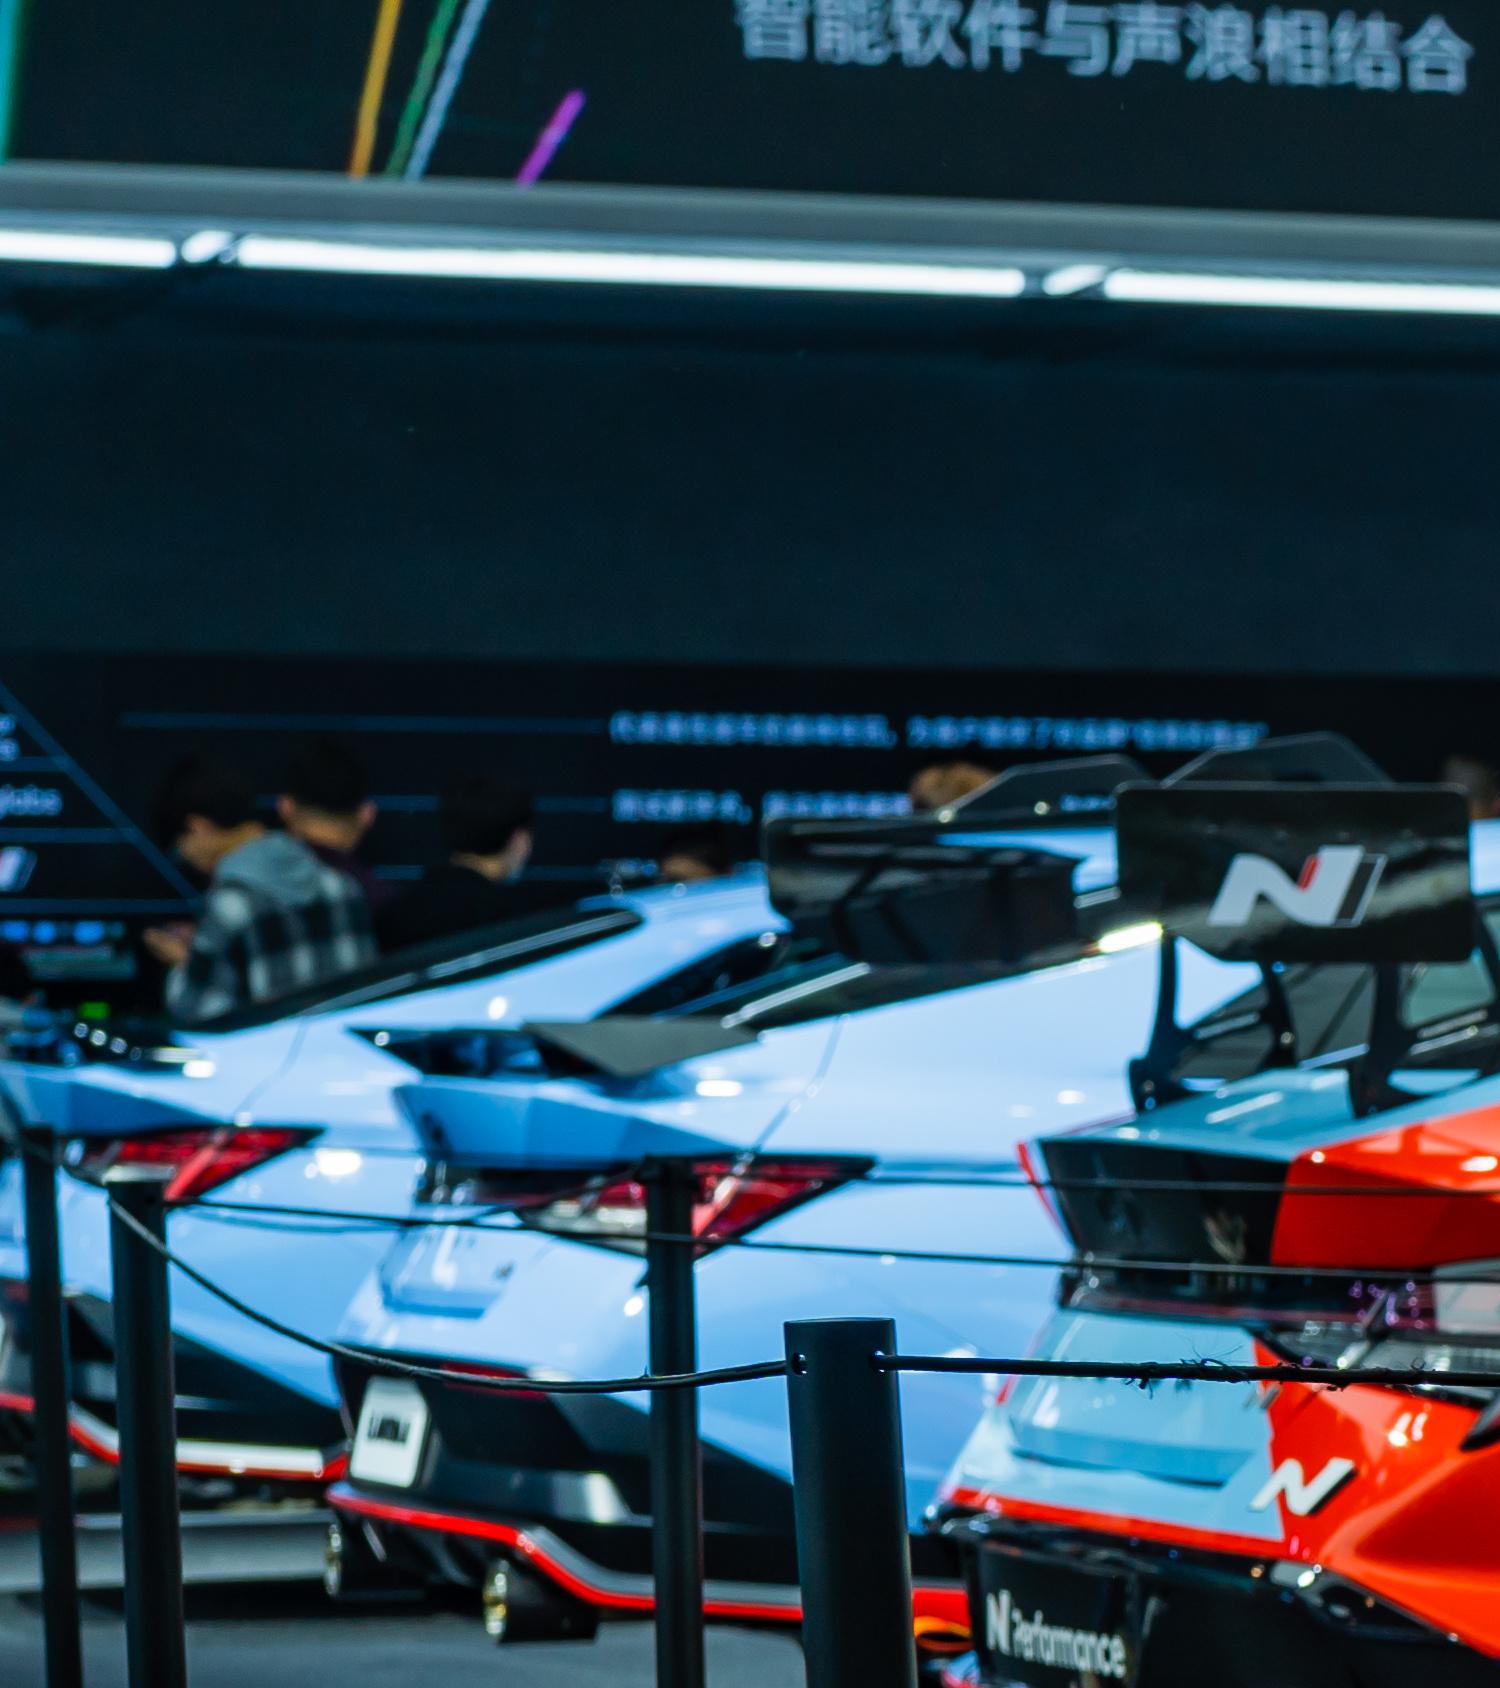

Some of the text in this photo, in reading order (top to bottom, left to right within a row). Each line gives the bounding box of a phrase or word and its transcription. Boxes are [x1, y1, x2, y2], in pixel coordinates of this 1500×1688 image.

[736, 0, 1474, 93] 智能软件与声浪相结合
[1207, 844, 1388, 928] N
[1249, 1456, 1357, 1516] N
[986, 1589, 1126, 1679] N Performance
